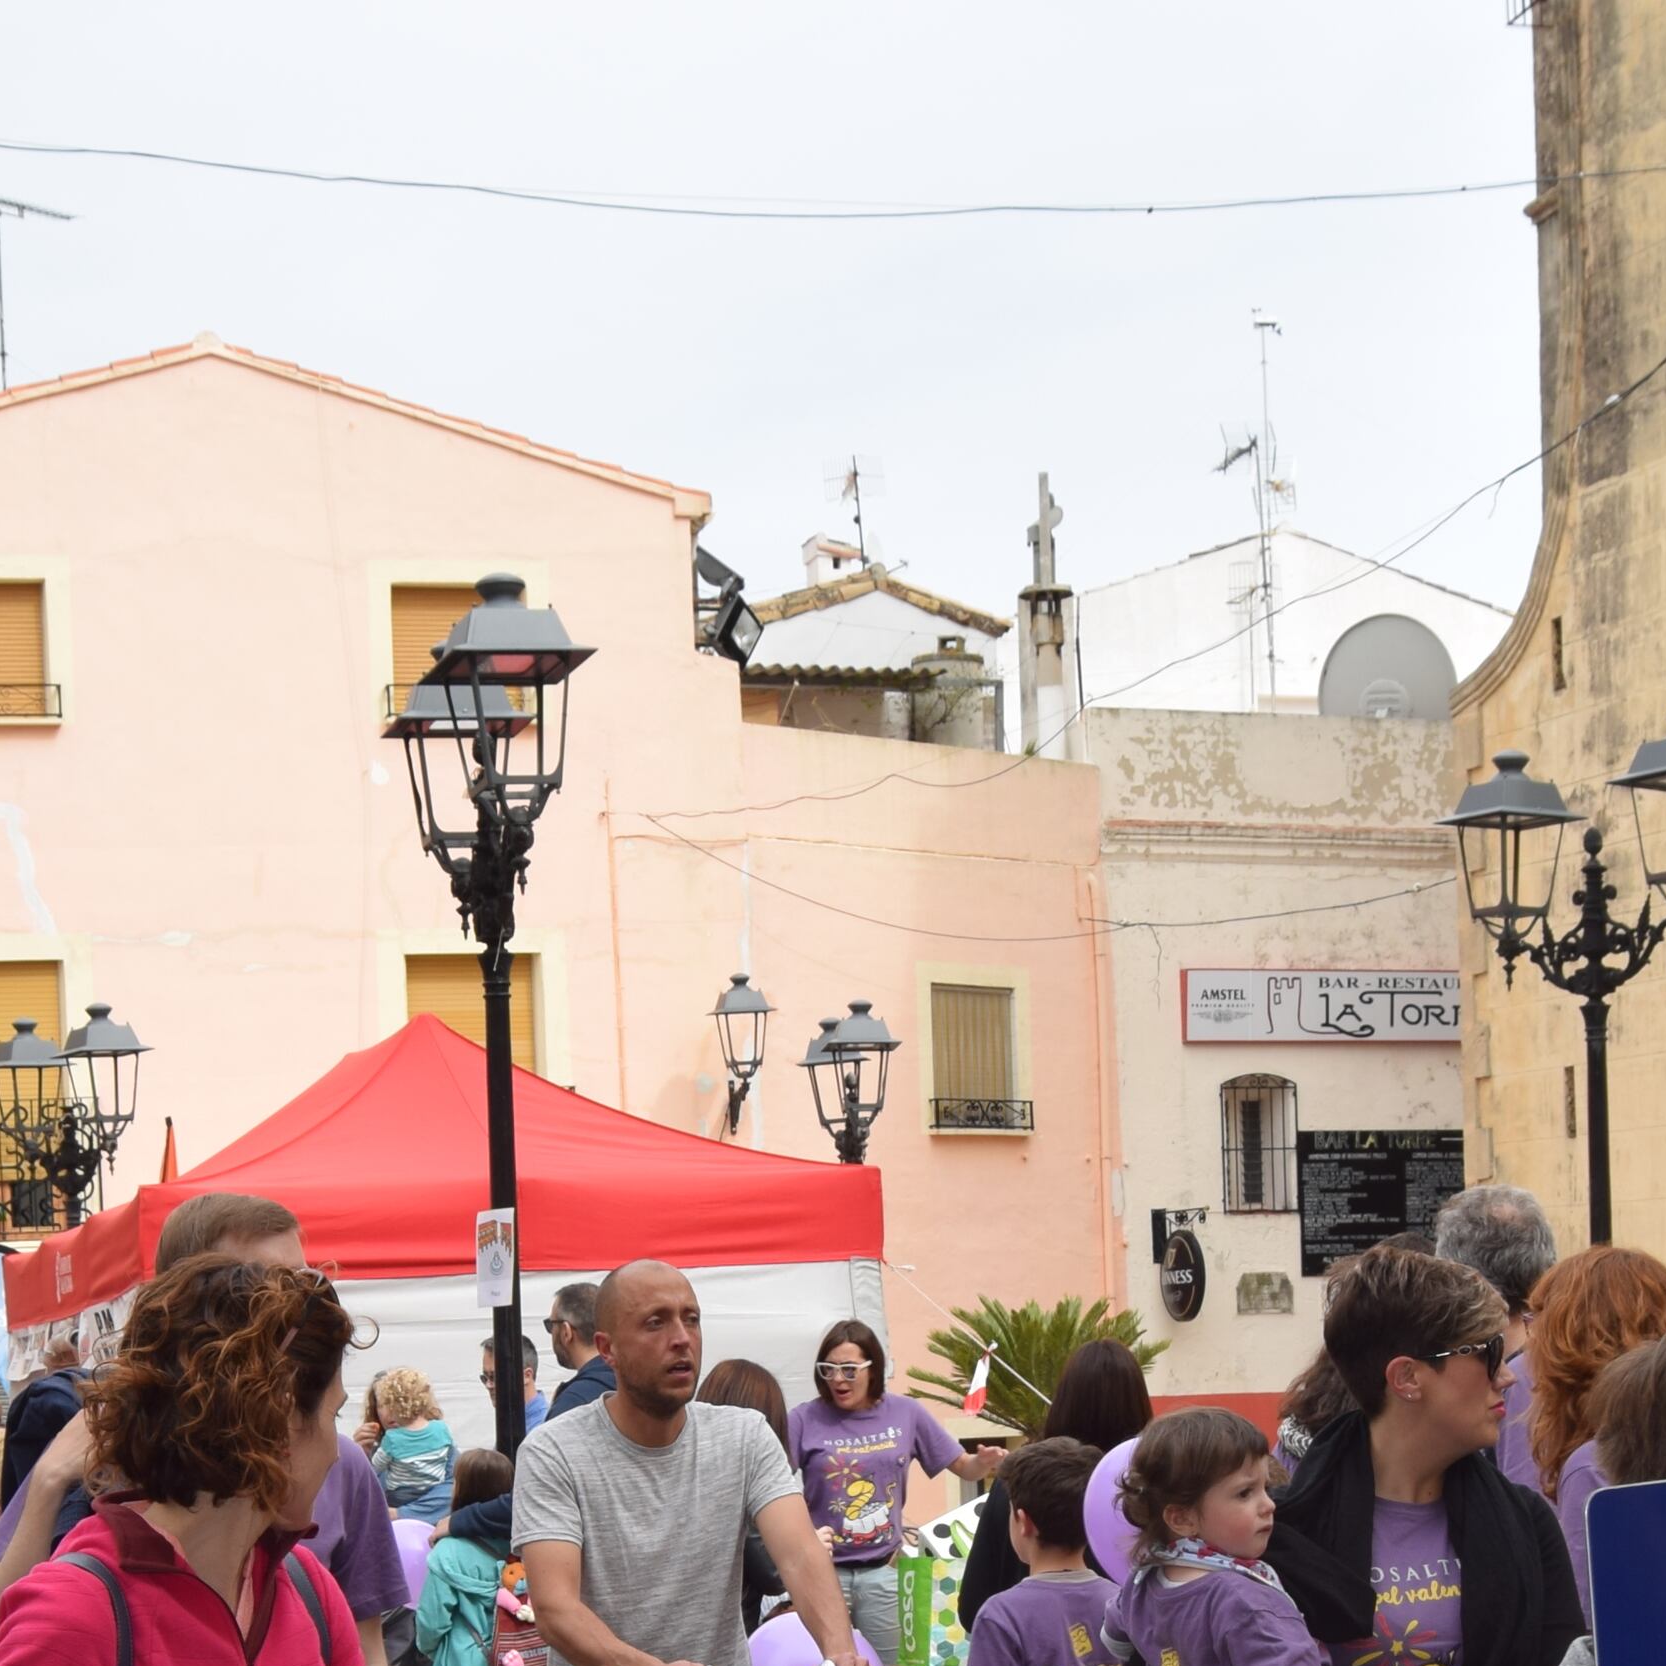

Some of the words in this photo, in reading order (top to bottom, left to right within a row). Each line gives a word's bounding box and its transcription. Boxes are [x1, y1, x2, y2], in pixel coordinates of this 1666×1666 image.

[1318, 977, 1358, 989] BAR
[1201, 989, 1246, 1001] AMSTEL
[1355, 1131, 1378, 1149] LA
[1370, 1558, 1461, 1583] OSALT
[1405, 1580, 1461, 1603] valen
[903, 1570, 915, 1652] casa
